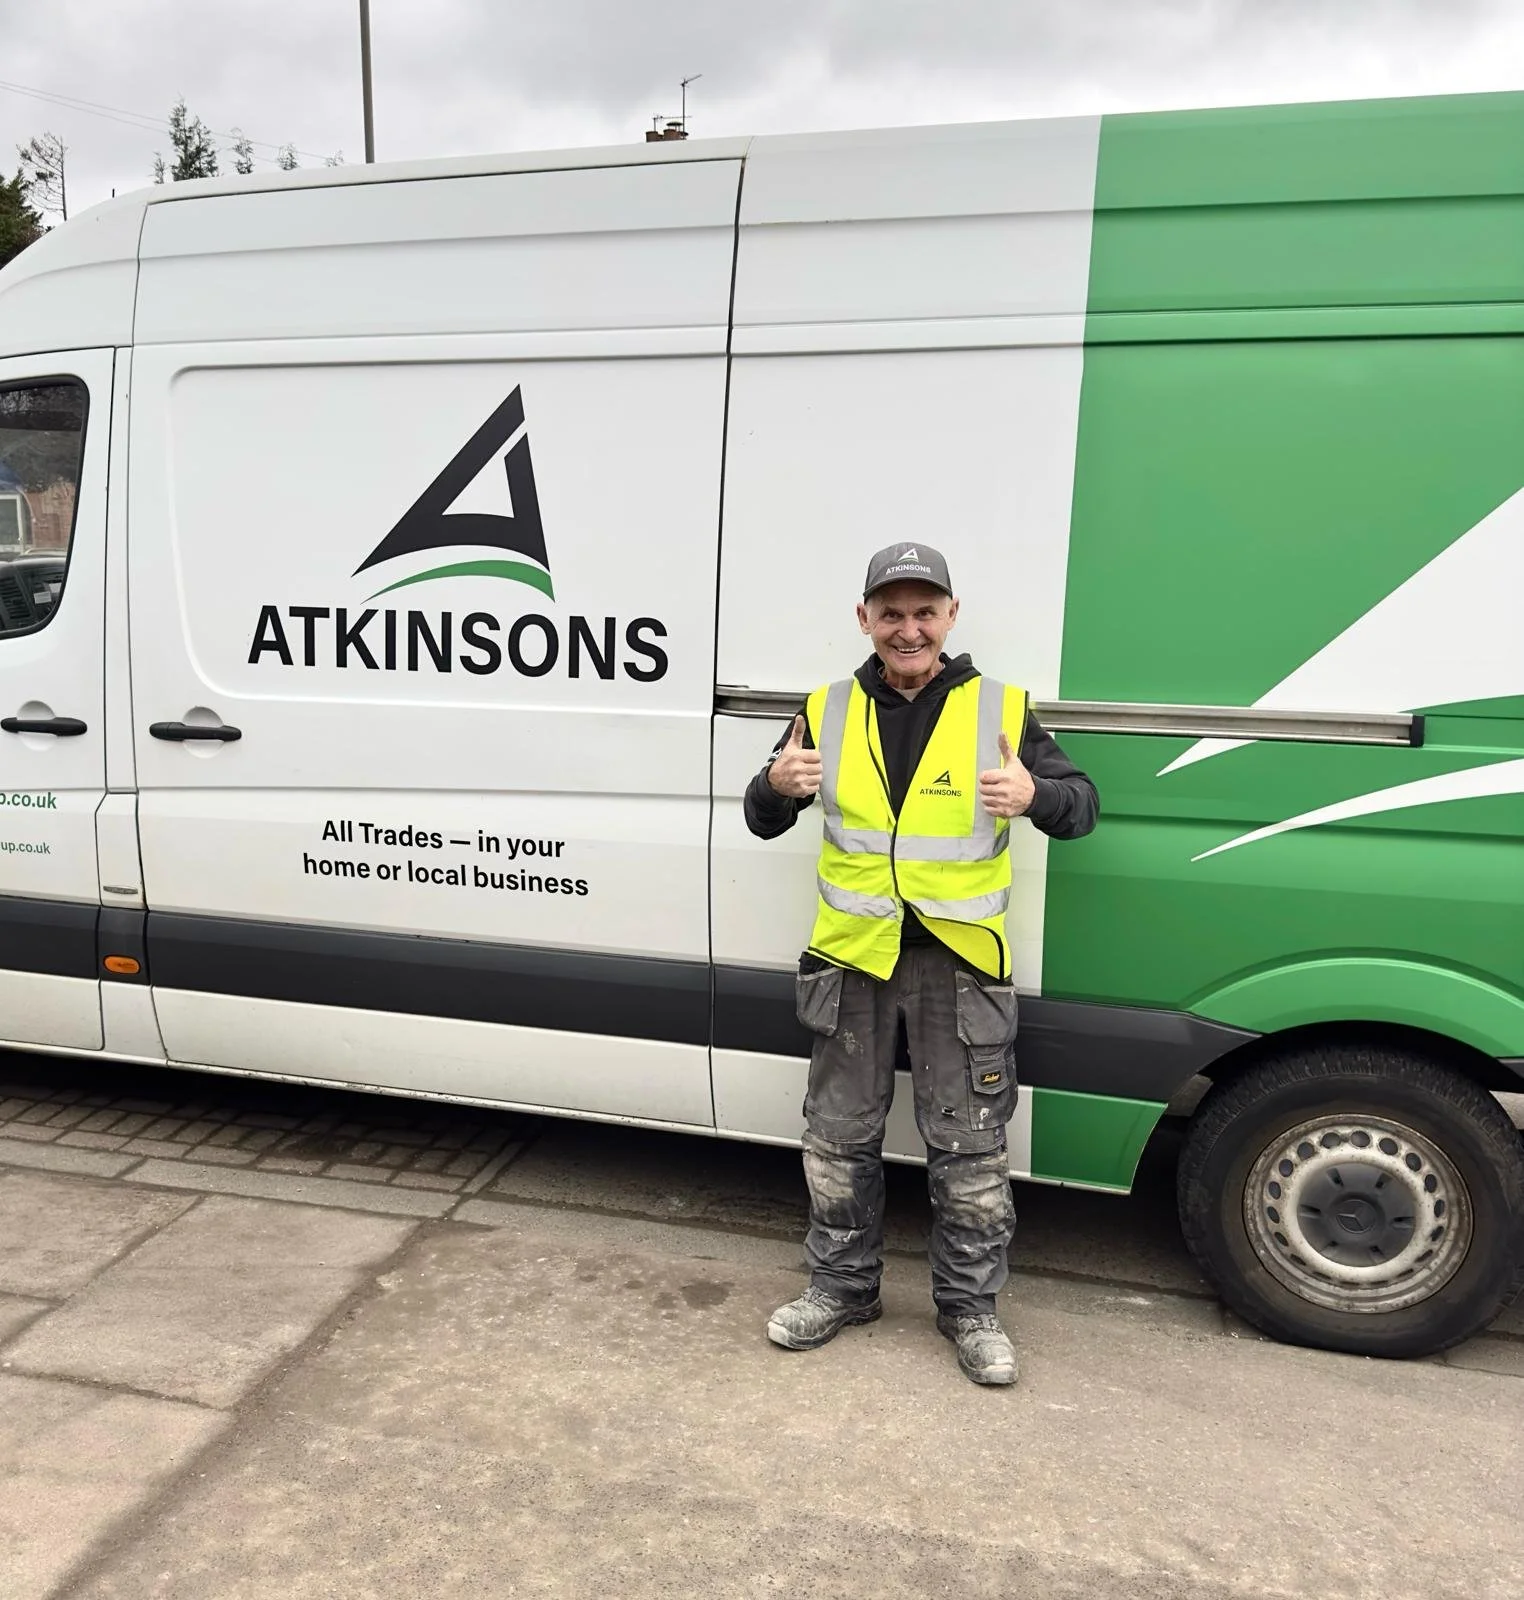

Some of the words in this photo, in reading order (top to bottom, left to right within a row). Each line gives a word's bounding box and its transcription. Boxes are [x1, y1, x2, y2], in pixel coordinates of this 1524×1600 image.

[885, 564, 931, 575] ATKINSONS
[247, 604, 669, 683] ATKINSONS
[920, 788, 962, 797] ATKINSONS
[0, 841, 51, 855] up.co.uk
[322, 820, 353, 843] All
[358, 822, 444, 850] Trades
[478, 829, 501, 854] in
[506, 837, 565, 861] your
[303, 852, 371, 879] home
[376, 863, 402, 881] or
[407, 860, 467, 887] local
[473, 865, 589, 897] business
